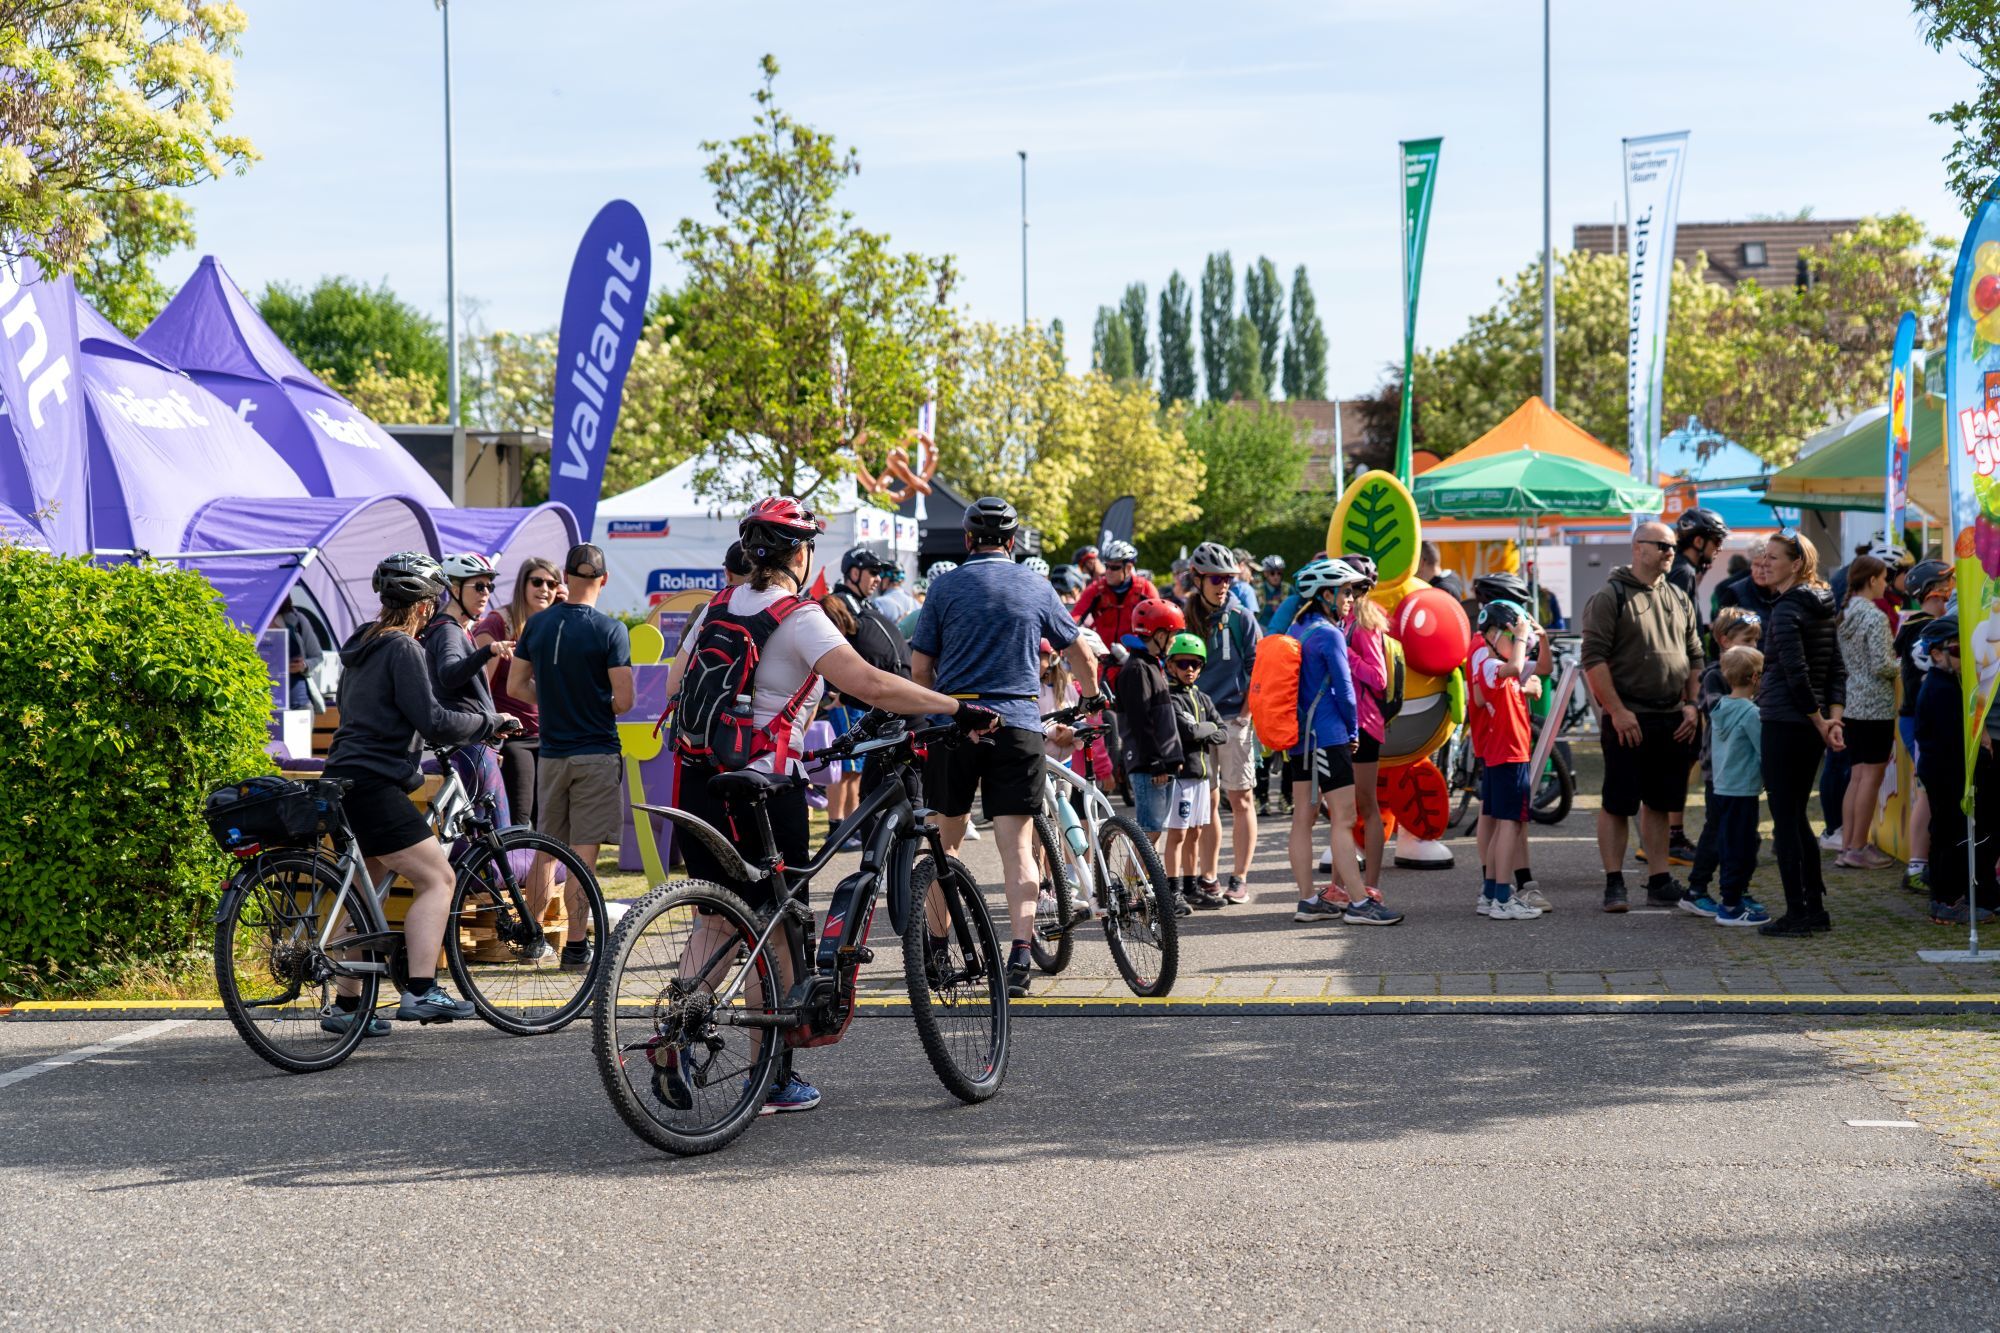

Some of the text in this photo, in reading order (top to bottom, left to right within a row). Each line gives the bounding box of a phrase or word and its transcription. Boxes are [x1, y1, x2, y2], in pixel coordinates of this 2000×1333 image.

[559, 241, 641, 481] valiant
[1959, 400, 2000, 456] lac
[659, 573, 717, 590] Roland
